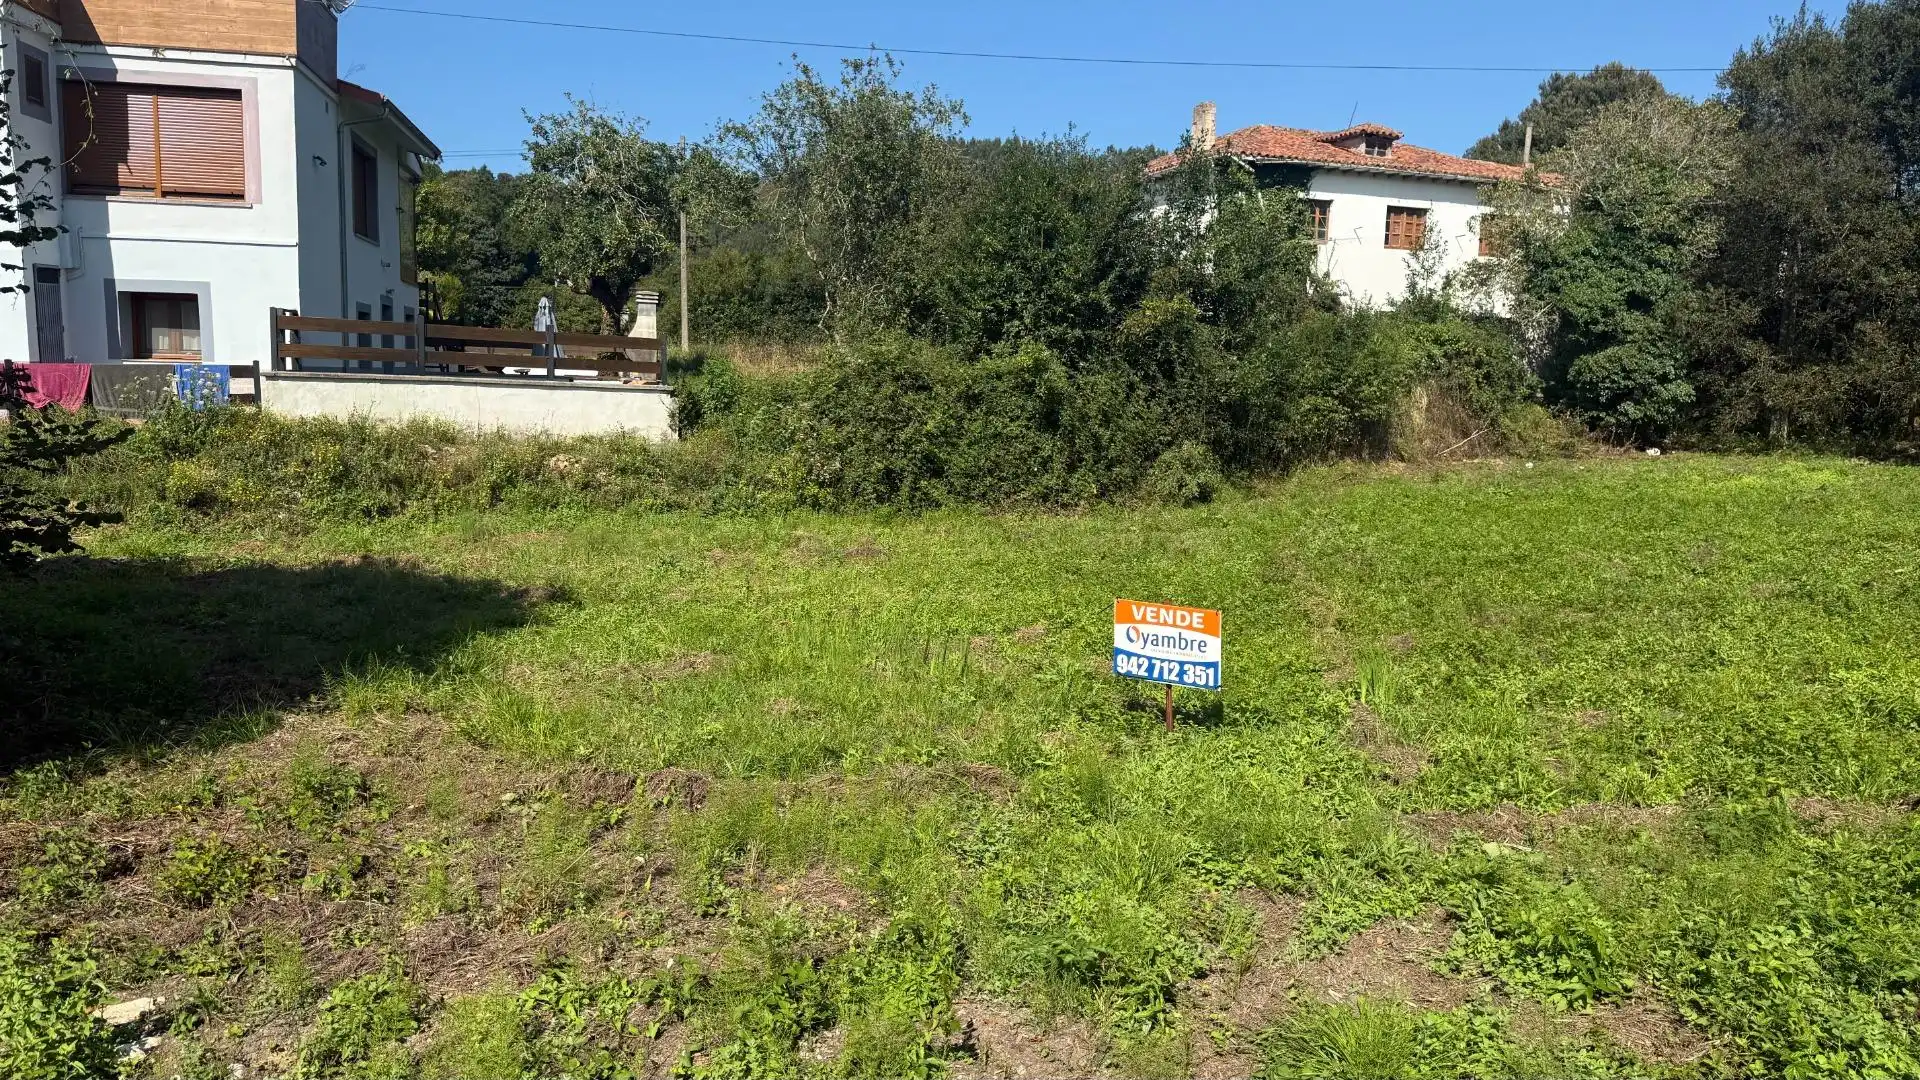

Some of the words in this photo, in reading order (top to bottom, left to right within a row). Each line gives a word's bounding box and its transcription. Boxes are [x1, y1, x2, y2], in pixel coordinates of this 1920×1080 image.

[1131, 604, 1205, 629] VENDE
[1126, 625, 1207, 653] Oyambre
[1116, 654, 1149, 677] 942
[1151, 659, 1180, 681] 712
[1183, 663, 1215, 687] 351
